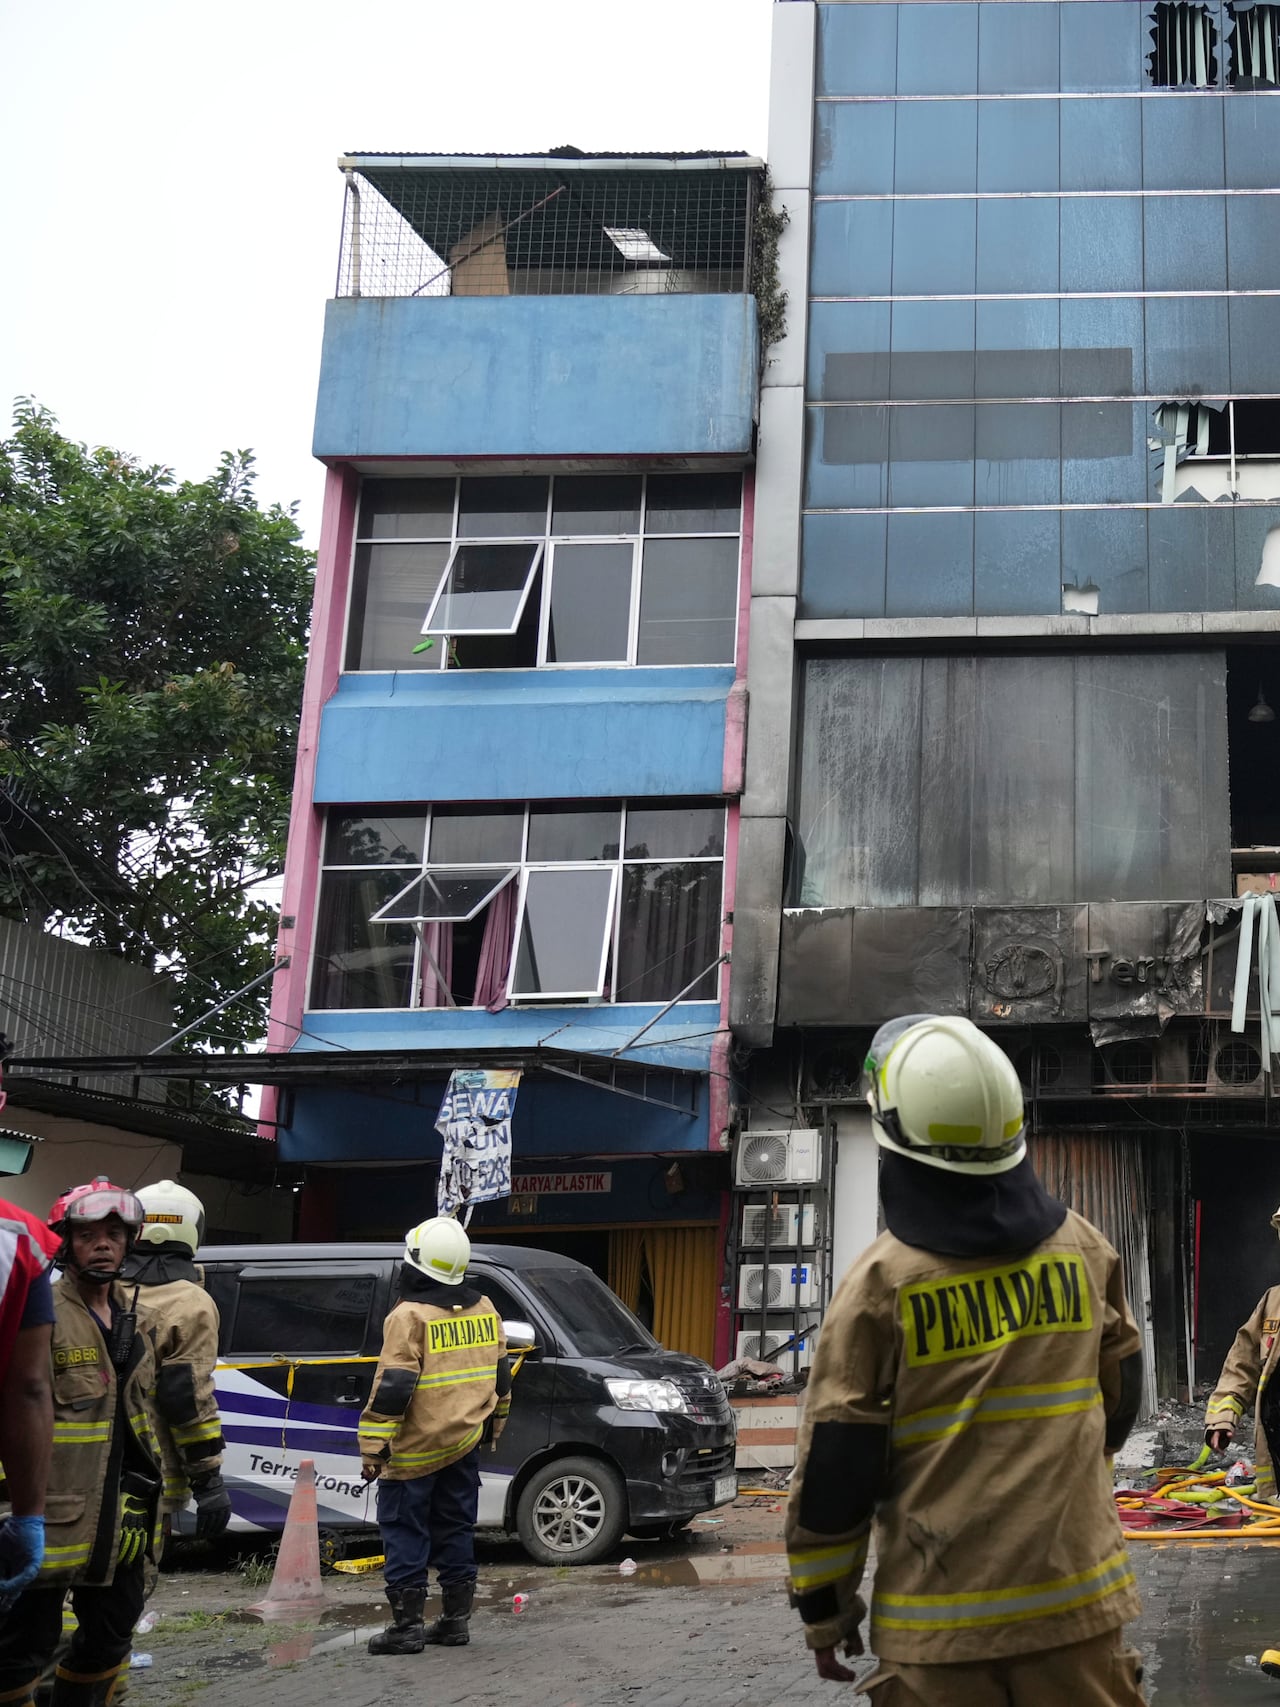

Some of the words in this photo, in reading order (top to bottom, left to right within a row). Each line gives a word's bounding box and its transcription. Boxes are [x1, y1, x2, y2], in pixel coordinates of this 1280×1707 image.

[440, 1090, 511, 1120] SEWA
[511, 1175, 552, 1193] KARYA
[554, 1173, 605, 1192] PLASTIK
[908, 1261, 1083, 1357] PEMADAM
[430, 1317, 495, 1350] PEMADAM
